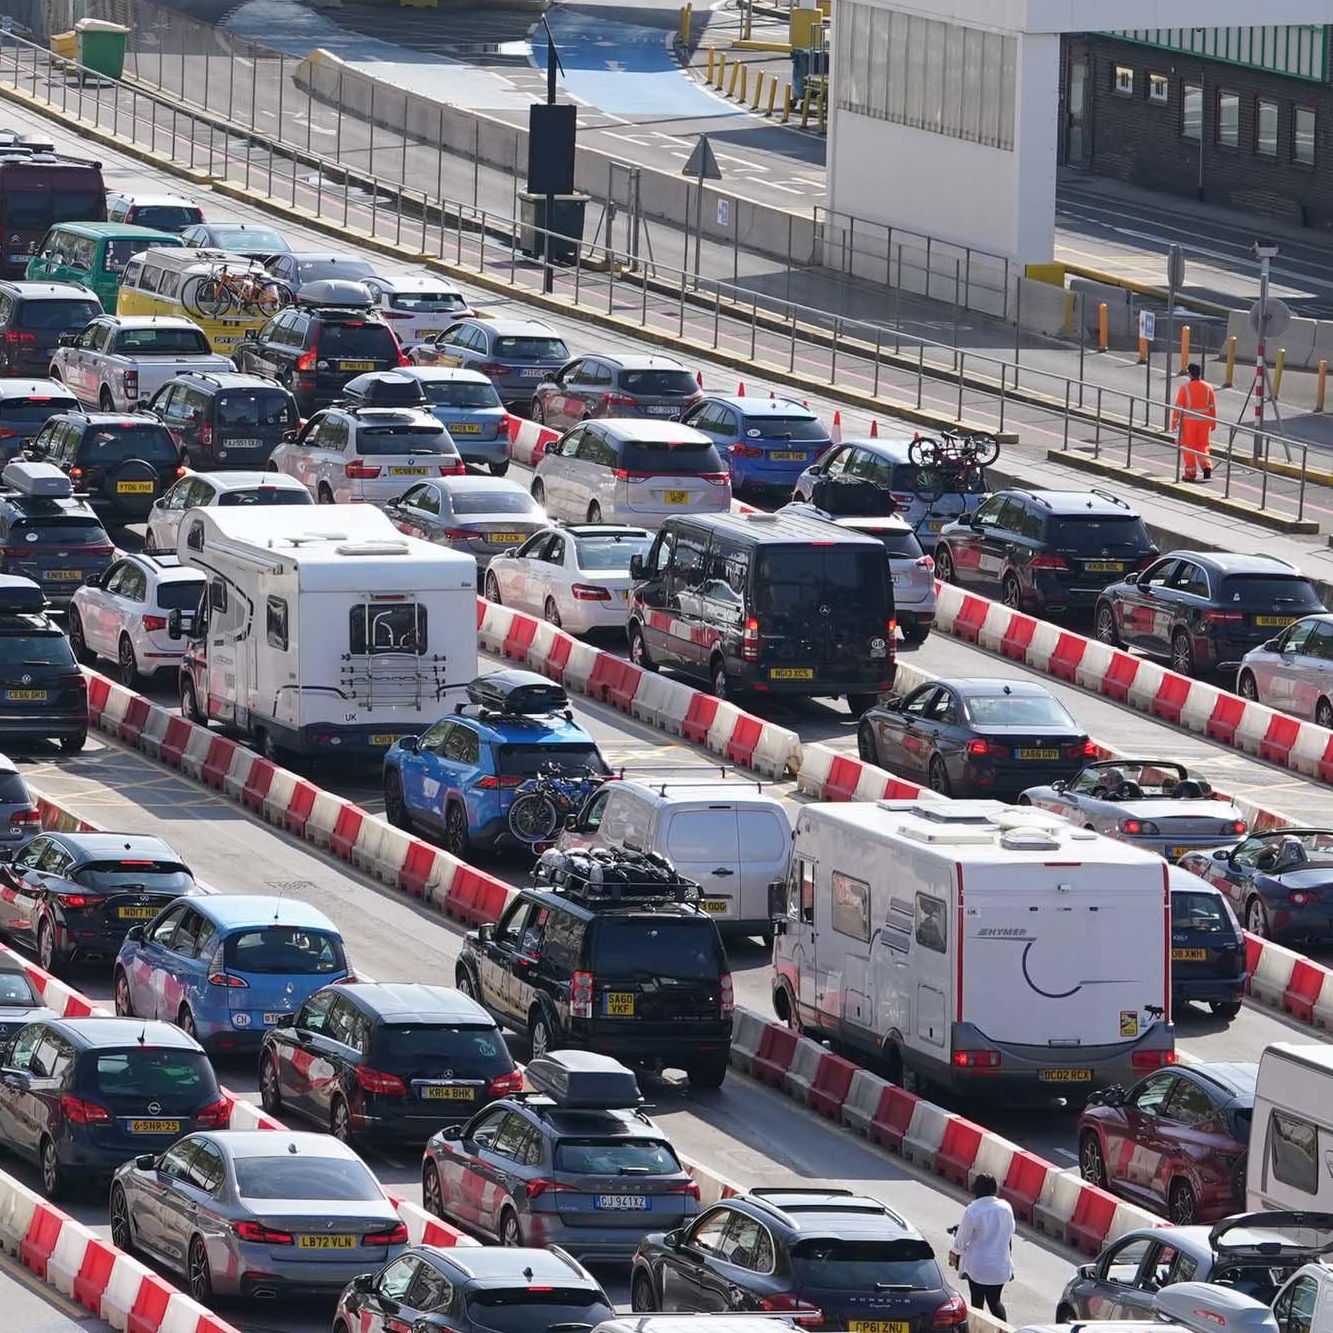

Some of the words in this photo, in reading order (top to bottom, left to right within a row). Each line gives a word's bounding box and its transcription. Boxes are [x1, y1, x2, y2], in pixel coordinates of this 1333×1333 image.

[345, 713, 357, 721] UK
[966, 908, 978, 916] UK
[608, 994, 633, 1004] SA60
[611, 1004, 630, 1014] VKF
[234, 1013, 251, 1025] CH
[429, 1088, 450, 1099] KR14
[453, 1088, 471, 1099] BHK
[302, 1236, 329, 1248] LB72
[331, 1236, 352, 1249] VLN
